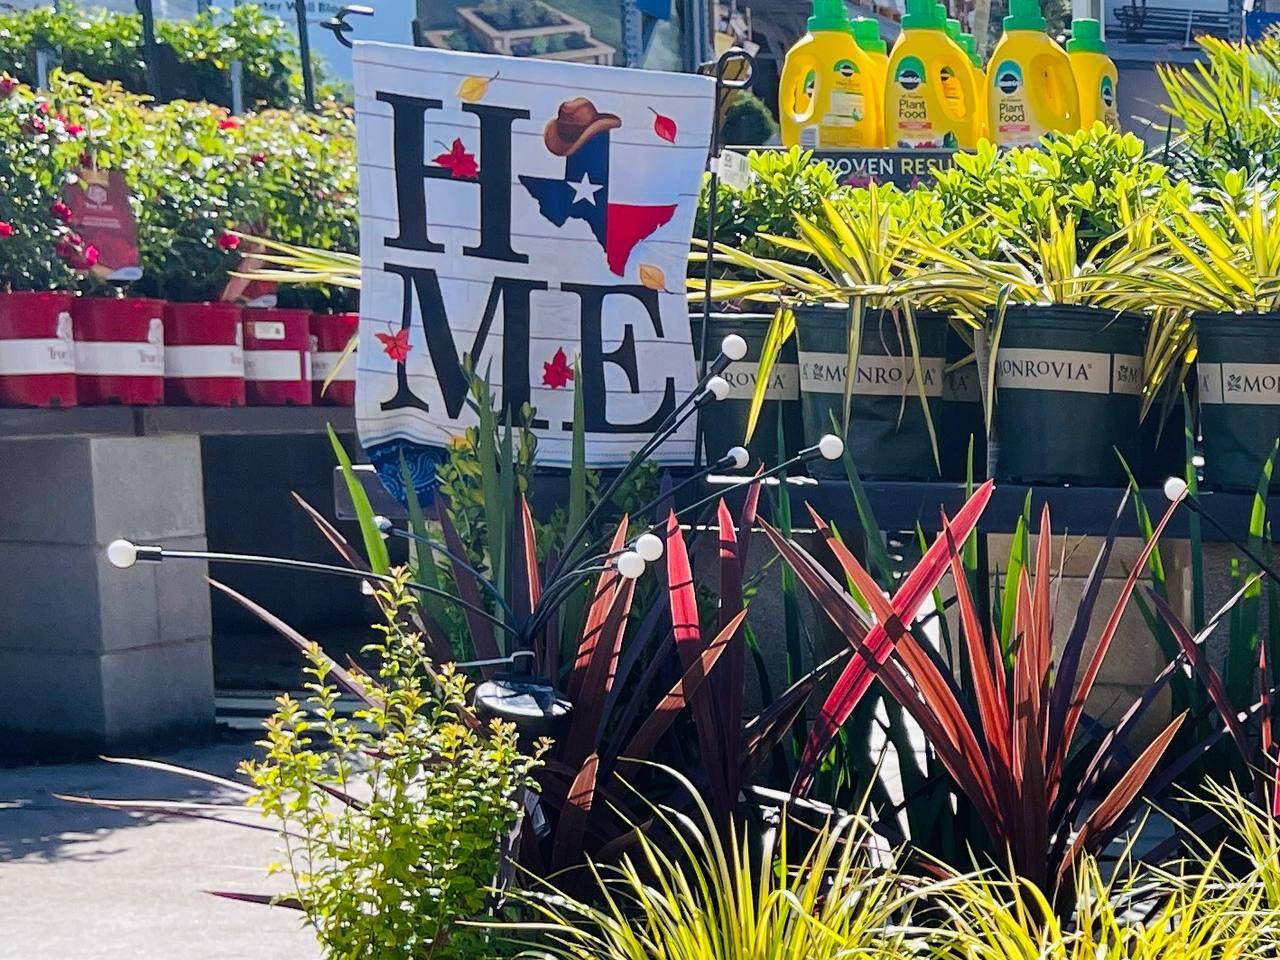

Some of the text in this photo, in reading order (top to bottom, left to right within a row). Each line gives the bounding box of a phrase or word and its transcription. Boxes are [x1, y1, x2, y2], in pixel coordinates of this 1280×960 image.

[899, 99, 925, 109] Plant
[1000, 103, 1024, 113] Plant
[899, 109, 927, 119] Food
[1000, 113, 1025, 122] Food
[380, 262, 678, 434] ME
